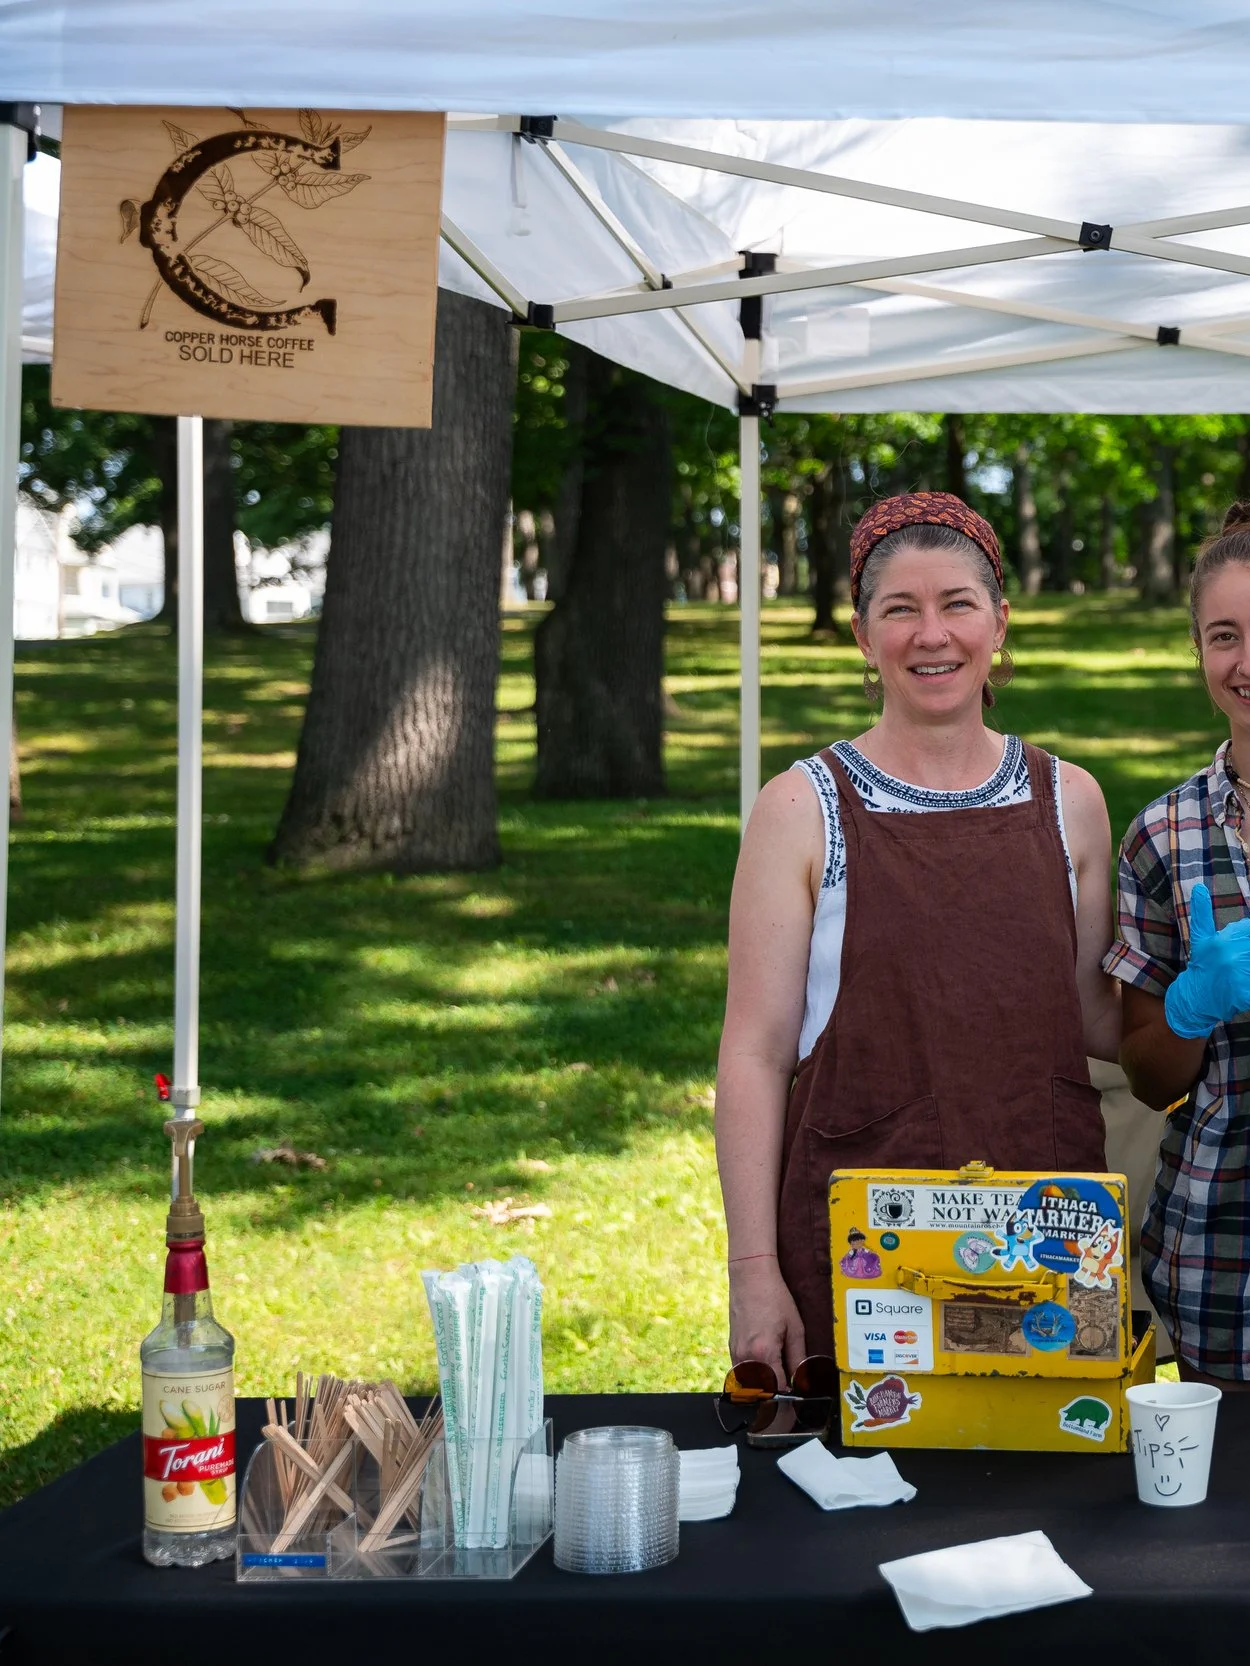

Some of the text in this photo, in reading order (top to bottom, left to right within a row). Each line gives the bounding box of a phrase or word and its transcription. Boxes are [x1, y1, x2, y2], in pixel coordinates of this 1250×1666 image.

[165, 331, 315, 350] COPPER HORSE COFFEE
[179, 345, 295, 368] SOLD HERE
[932, 1192, 984, 1206] MAKE
[1042, 1196, 1098, 1213] ITHACA
[933, 1207, 976, 1220] NOT
[876, 1302, 923, 1316] Square
[864, 1333, 887, 1341] VISA
[164, 1381, 226, 1394] CANE SUGAR
[442, 1379, 455, 1418] CERTIFIED
[1134, 1429, 1175, 1468] Tips
[160, 1438, 225, 1480] Torani
